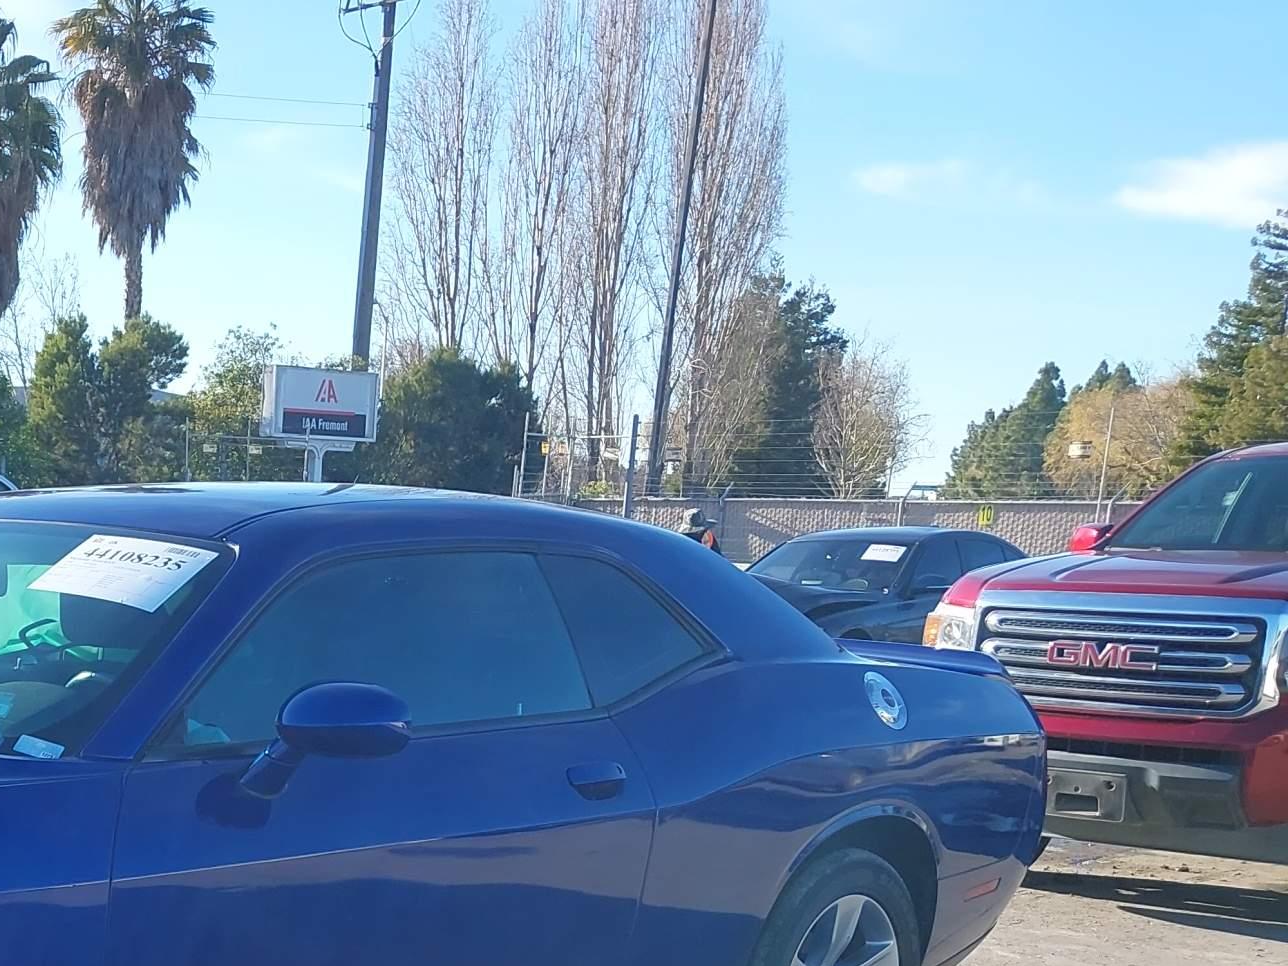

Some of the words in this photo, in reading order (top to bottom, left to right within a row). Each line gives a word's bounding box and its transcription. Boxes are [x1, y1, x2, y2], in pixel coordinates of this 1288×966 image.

[303, 418, 316, 430] IAA
[318, 418, 348, 431] Fremont
[981, 505, 993, 522] 10
[84, 547, 187, 571] 44108235
[1047, 639, 1160, 671] GMC
